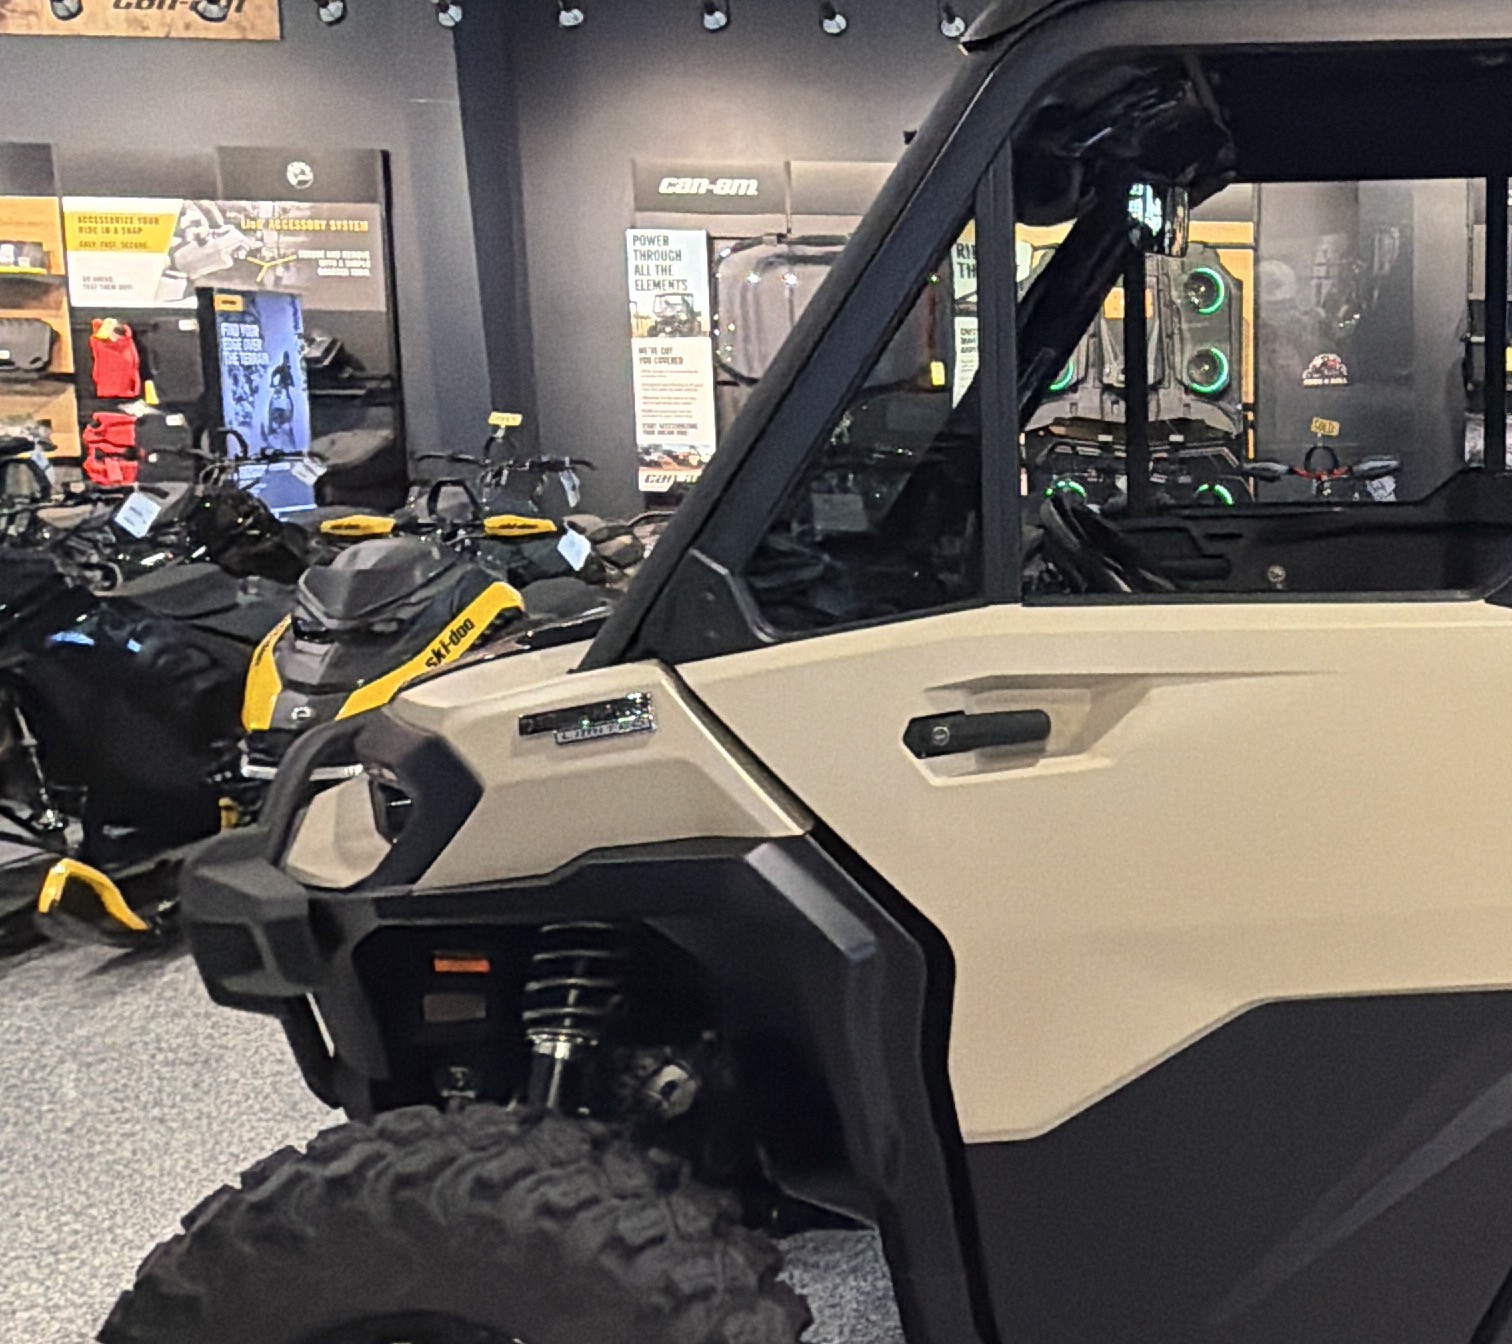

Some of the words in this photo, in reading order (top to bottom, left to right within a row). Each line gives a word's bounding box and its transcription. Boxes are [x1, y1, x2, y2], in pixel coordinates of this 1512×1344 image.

[658, 177, 758, 196] can-am
[329, 219, 369, 232] SYSTEM
[632, 234, 669, 247] POWER
[633, 249, 682, 262] THROUGH
[634, 264, 651, 277] ALL
[654, 264, 673, 277] THE
[634, 278, 688, 292] ELEMENTS
[424, 616, 477, 670] ski-doo
